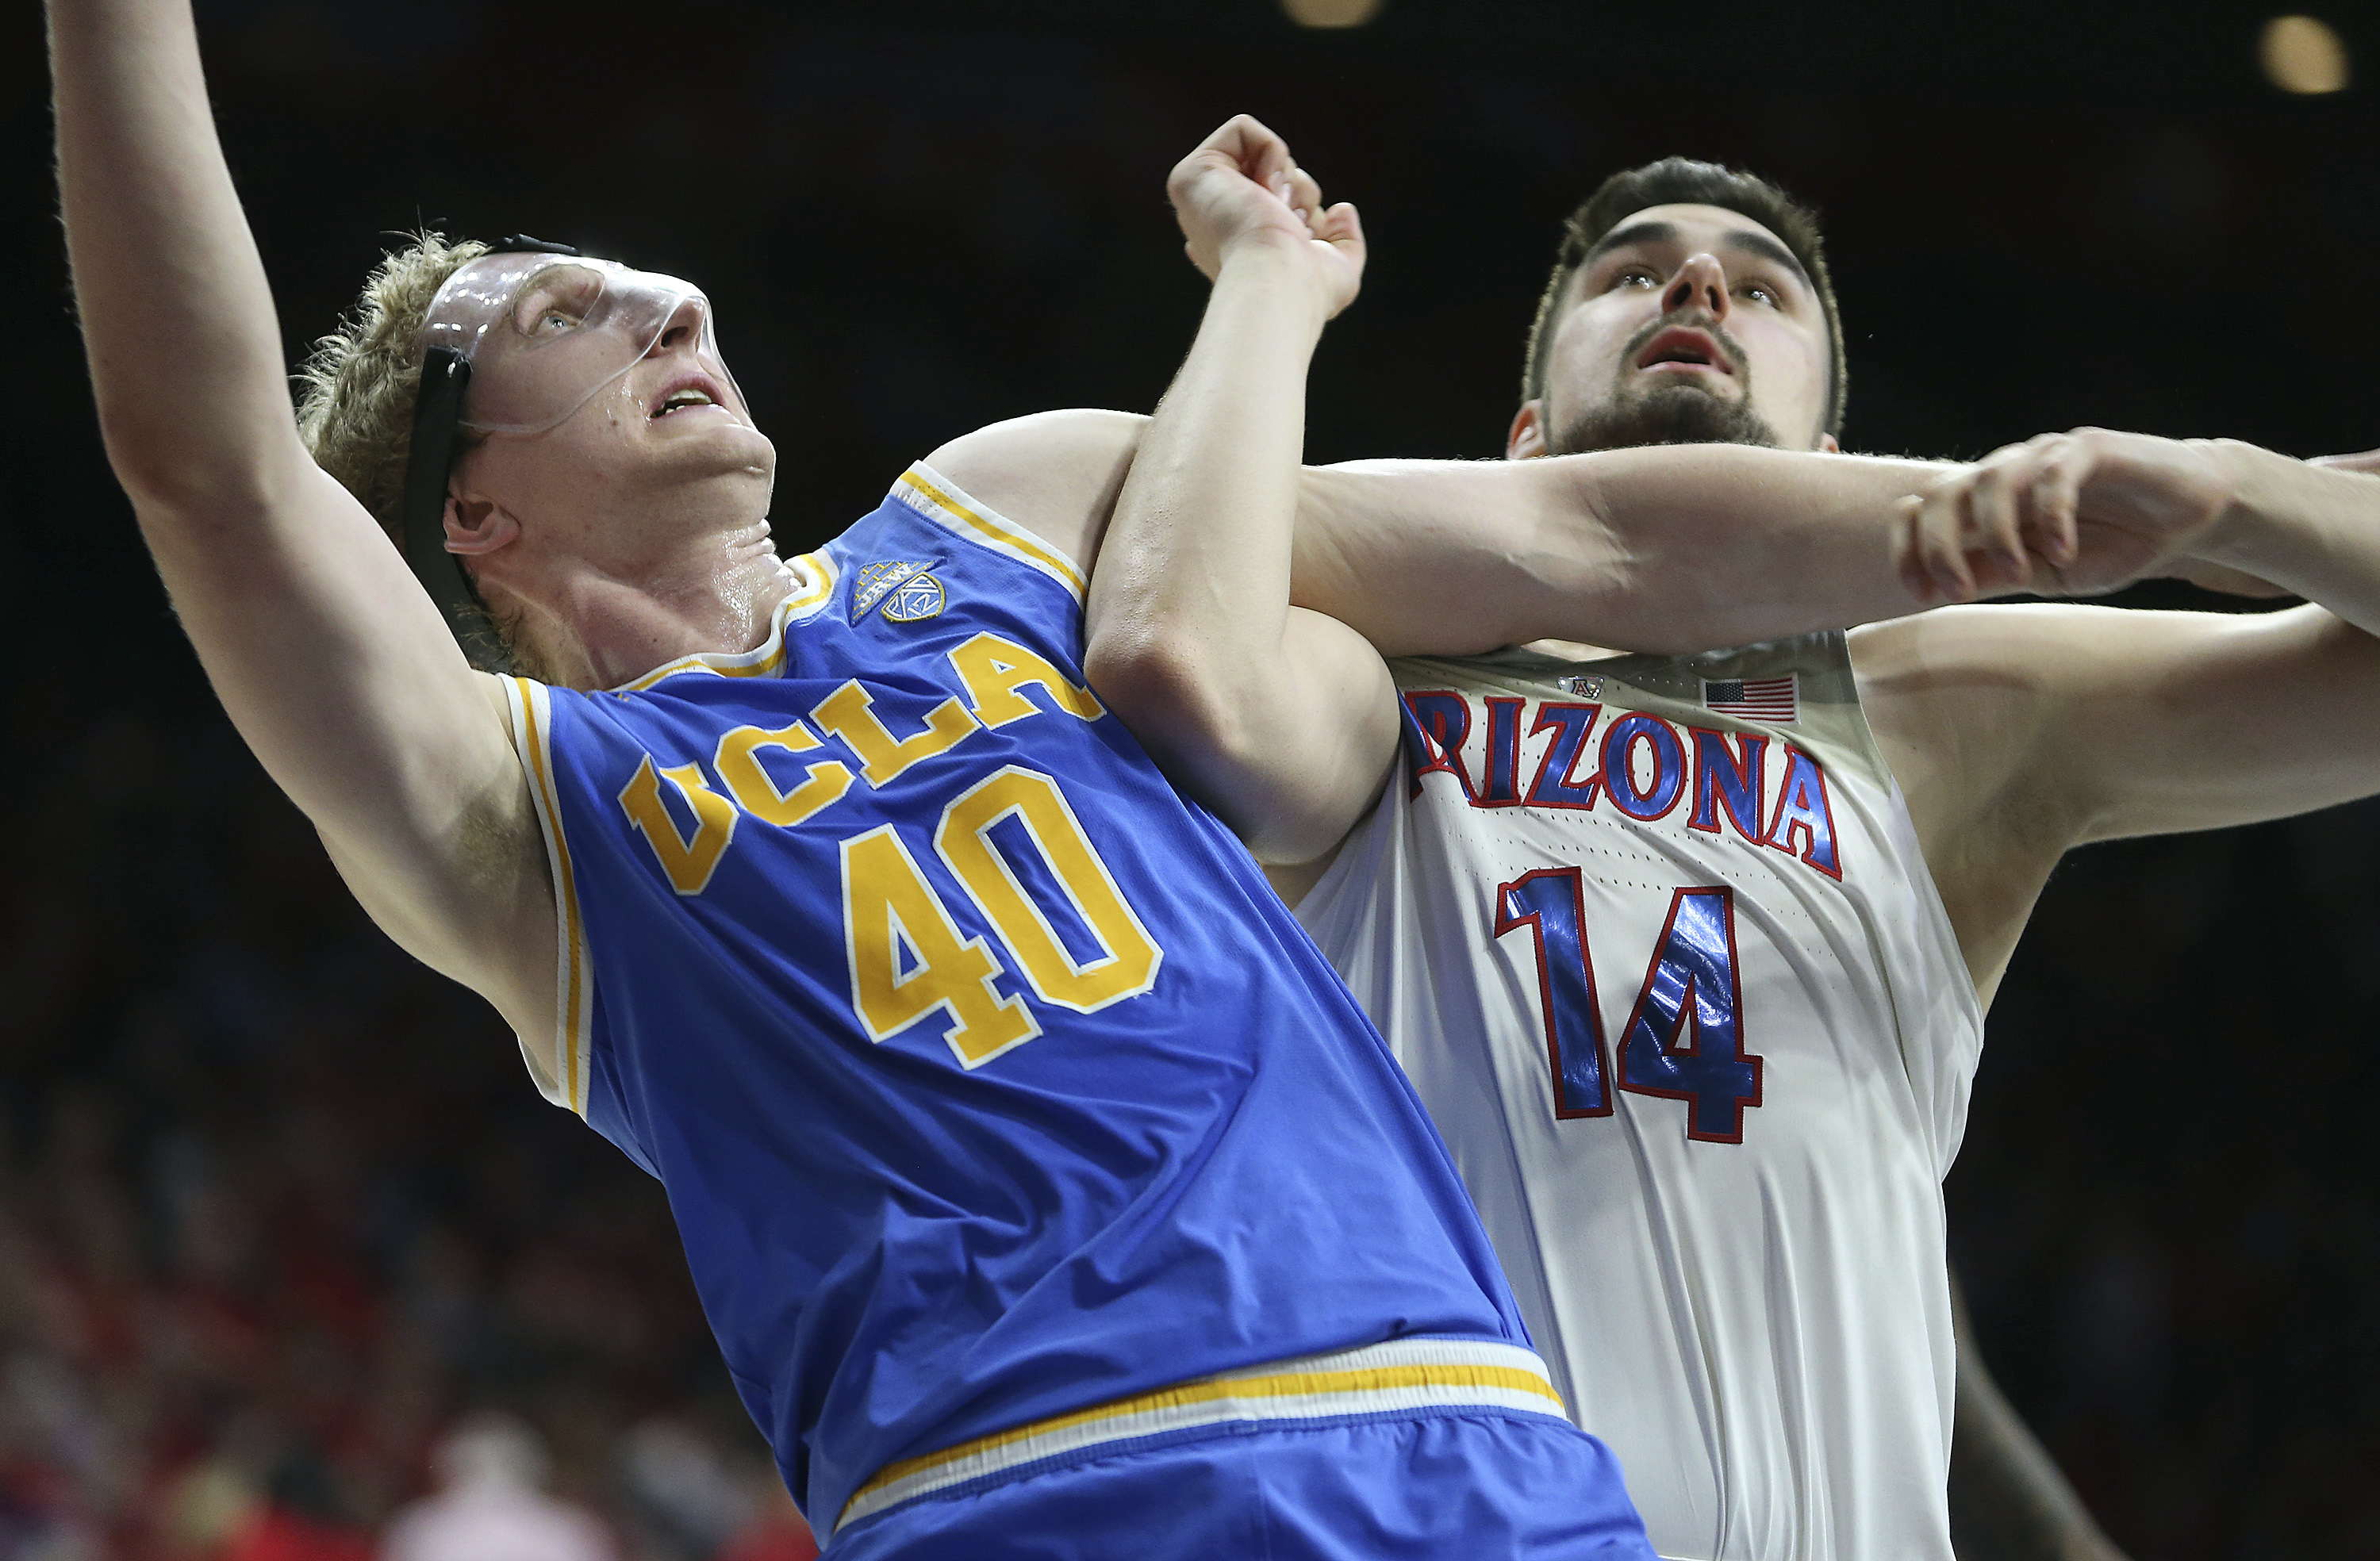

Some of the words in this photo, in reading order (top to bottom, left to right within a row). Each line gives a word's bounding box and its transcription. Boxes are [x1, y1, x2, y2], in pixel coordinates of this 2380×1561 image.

[859, 564, 913, 608] JRW
[617, 631, 1107, 896] UCLA
[1398, 690, 1842, 881] RIZONA
[839, 764, 1164, 1071] 40
[1495, 866, 1763, 1144] 14
